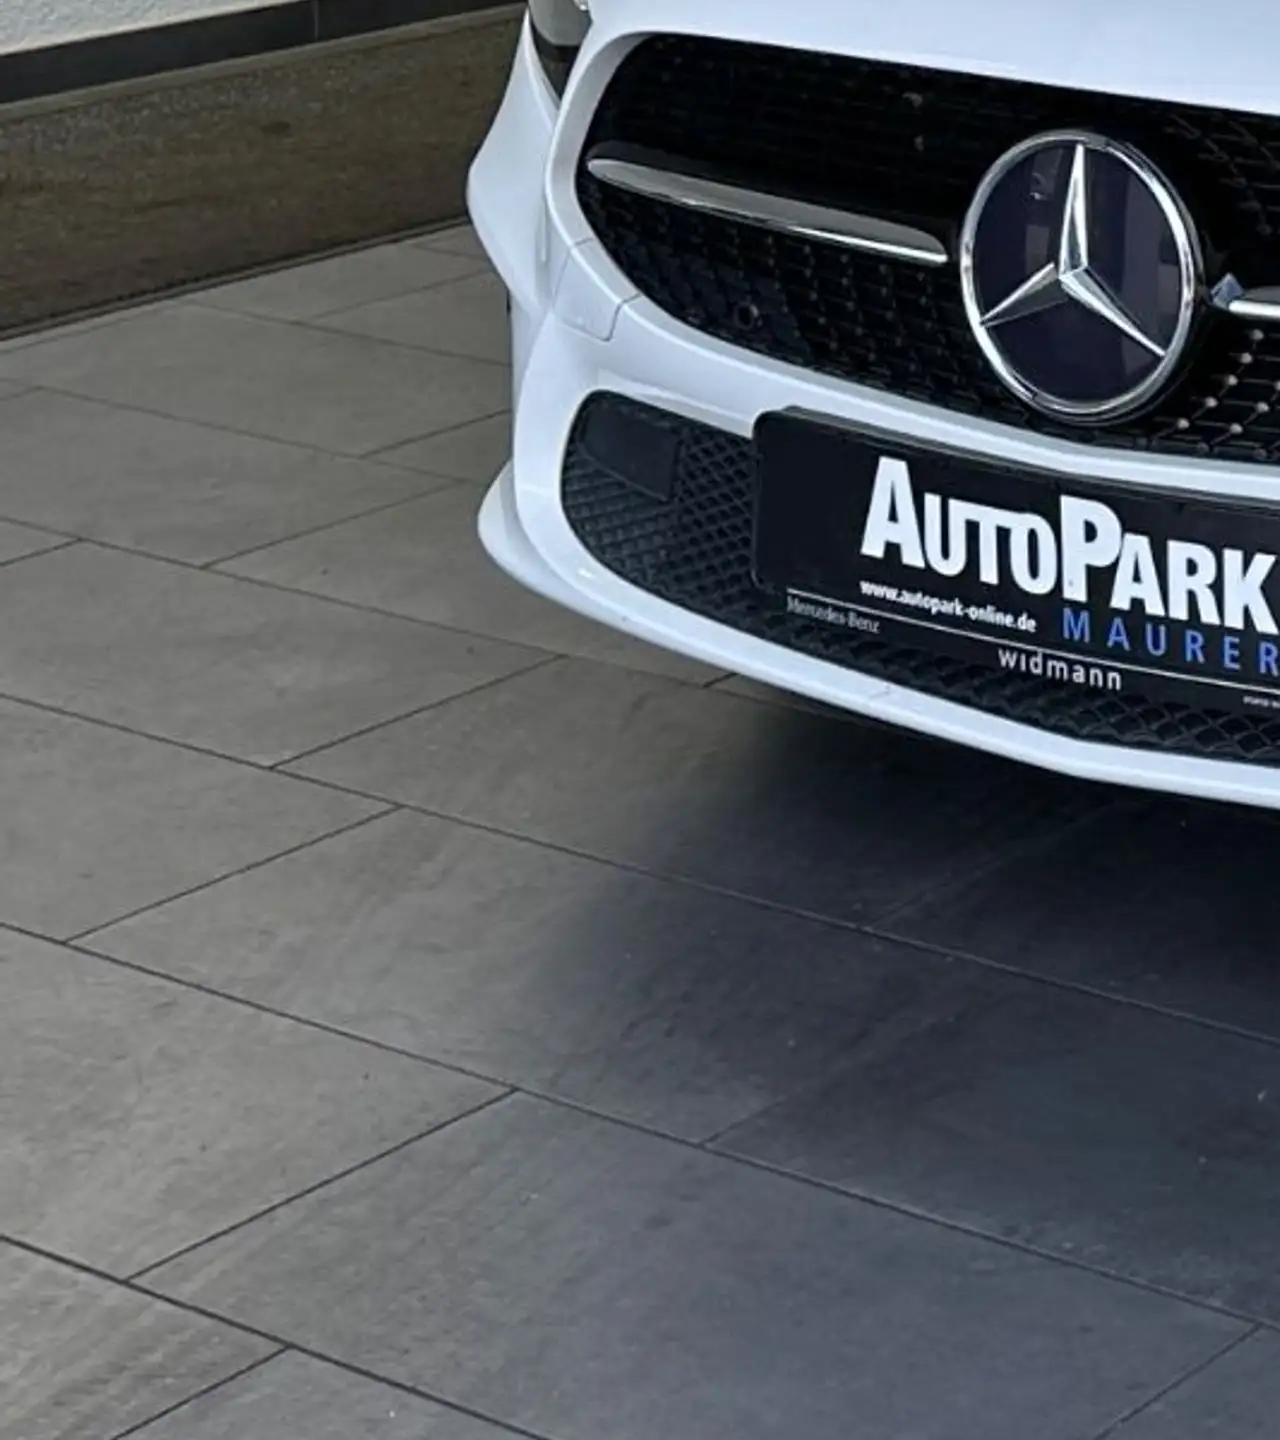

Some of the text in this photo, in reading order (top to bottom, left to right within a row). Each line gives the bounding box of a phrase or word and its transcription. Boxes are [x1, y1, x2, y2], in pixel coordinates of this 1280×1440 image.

[787, 596, 881, 634] Mercedes-Benz
[859, 579, 1037, 633] www.autopark-online.de
[1062, 609, 1280, 677] MAURER
[998, 646, 1122, 691] widmann
